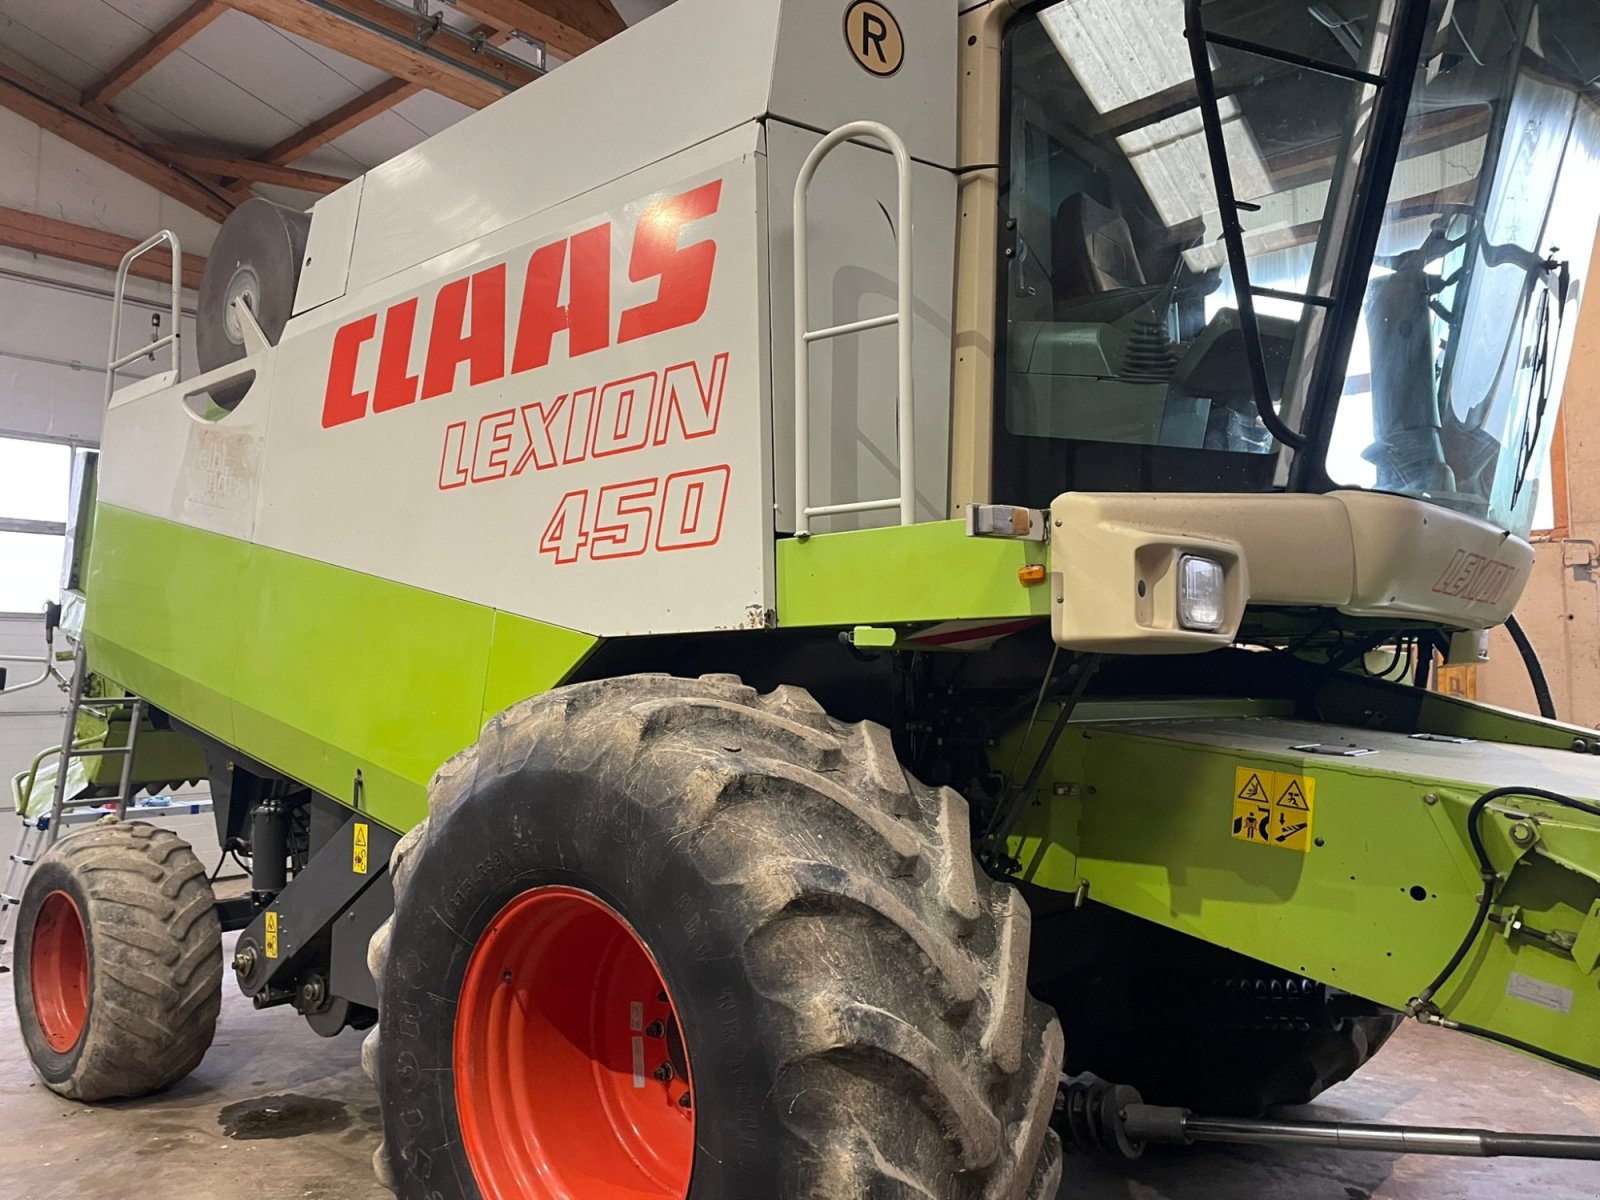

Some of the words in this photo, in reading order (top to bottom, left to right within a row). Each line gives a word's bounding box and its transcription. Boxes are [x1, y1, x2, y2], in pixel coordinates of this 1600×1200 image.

[863, 11, 887, 64] R
[321, 178, 723, 429] CLAAS
[439, 352, 729, 491] LEXION
[539, 464, 730, 565] 450
[1431, 548, 1520, 605] LEXION
